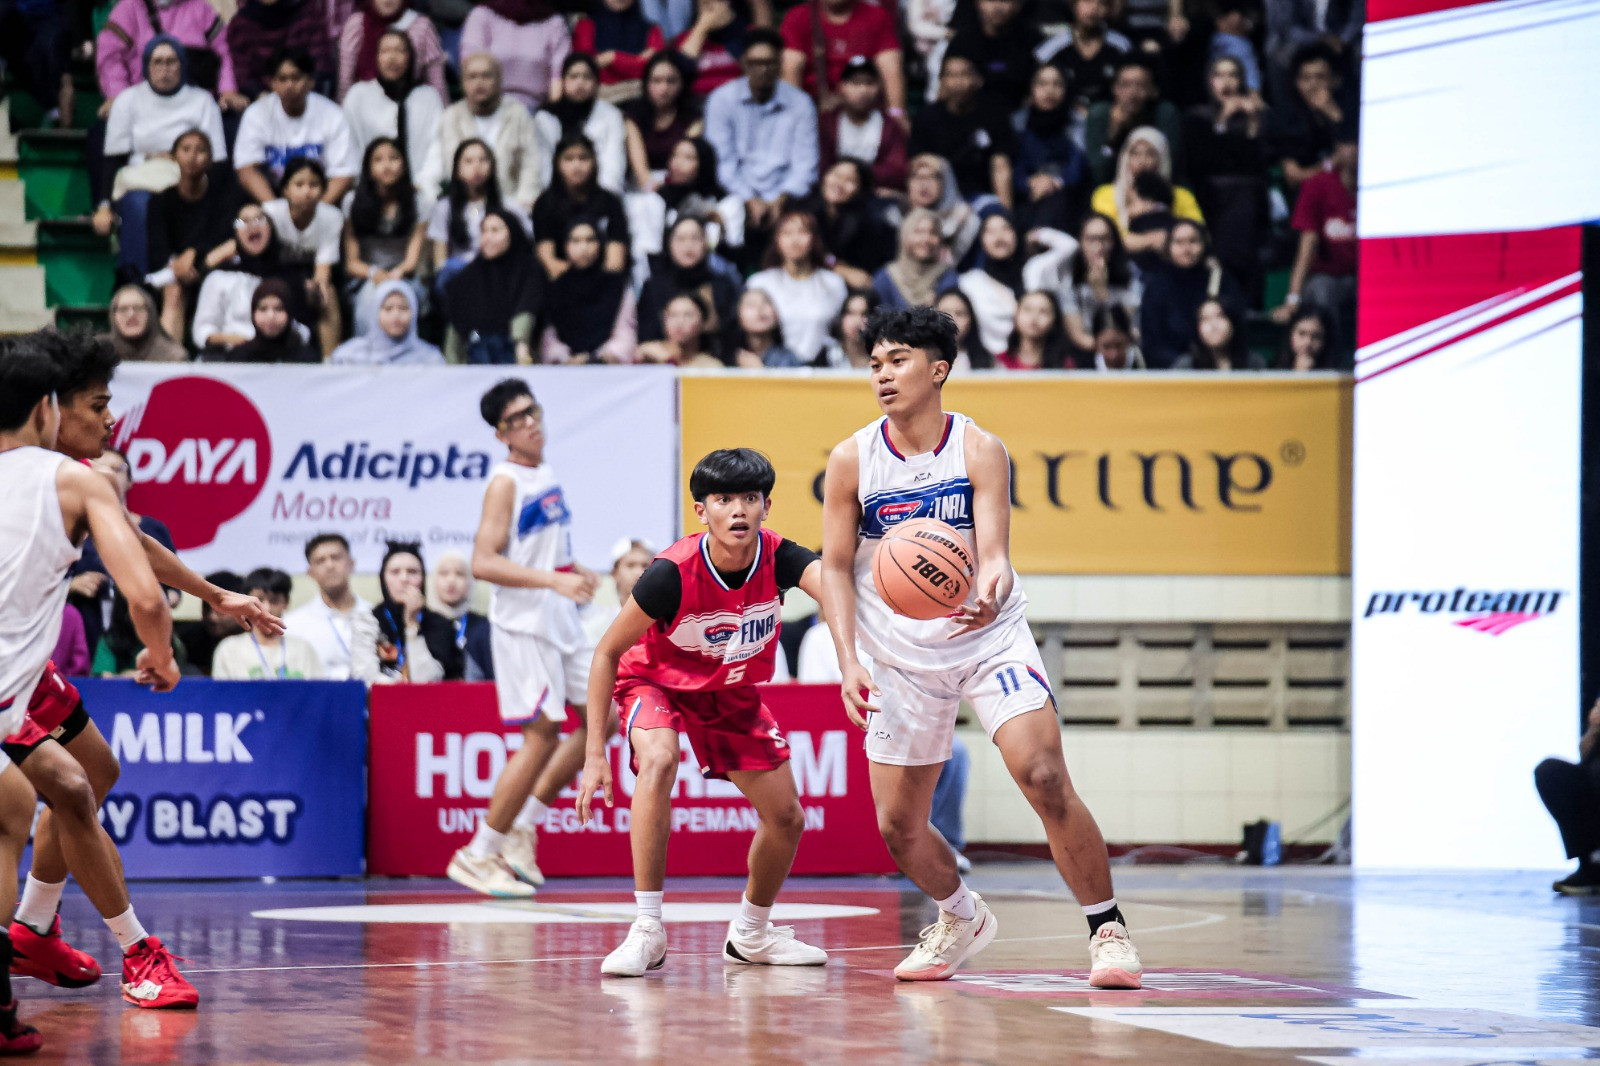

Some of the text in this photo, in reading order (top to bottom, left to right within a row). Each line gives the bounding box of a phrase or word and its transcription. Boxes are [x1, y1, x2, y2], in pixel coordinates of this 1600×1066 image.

[127, 437, 257, 484] DAYA
[283, 441, 491, 489] Adicipta
[271, 490, 392, 522] Motora
[911, 554, 950, 588] DBL
[1363, 586, 1563, 619] proteam
[723, 663, 748, 686] 5
[995, 665, 1022, 698] 11
[112, 712, 254, 763] MILK
[153, 799, 297, 840] BLAST
